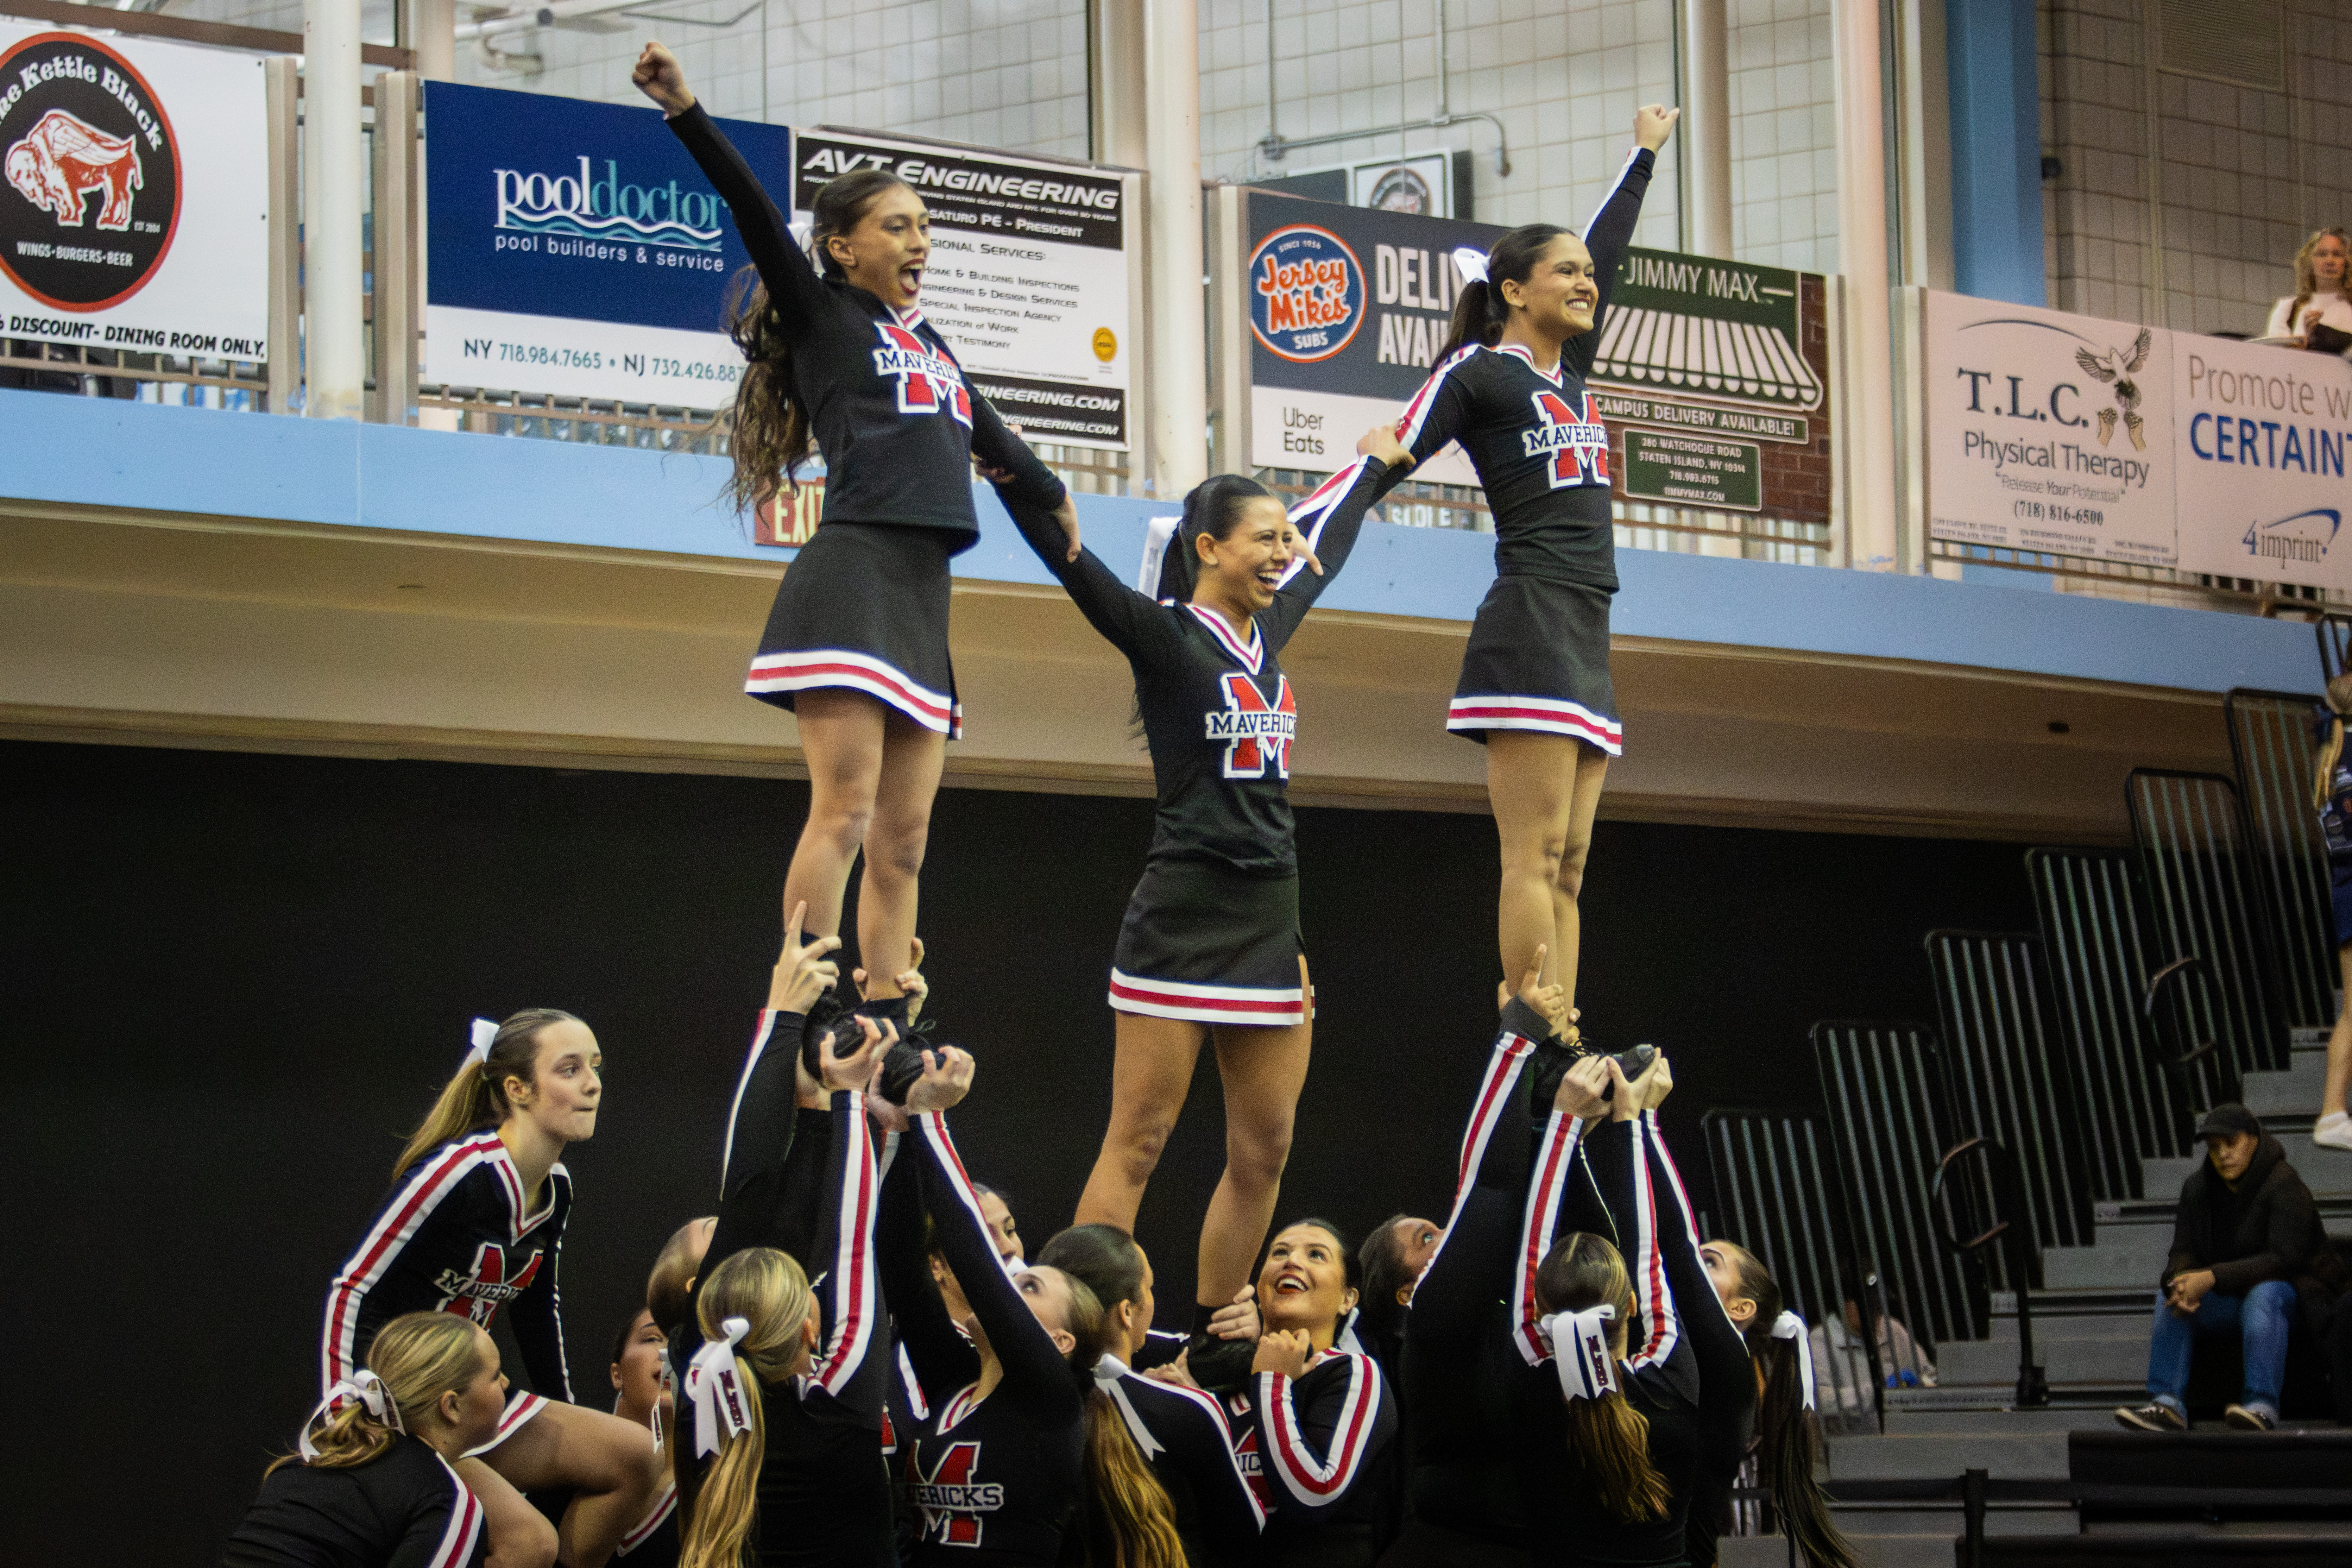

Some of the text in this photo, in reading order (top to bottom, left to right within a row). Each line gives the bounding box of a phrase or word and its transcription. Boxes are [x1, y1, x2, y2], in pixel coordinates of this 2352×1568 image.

[19, 56, 97, 93] Kettle
[101, 66, 163, 151] Black
[802, 148, 1120, 210] AVT ENGINEERING
[982, 213, 1002, 228] PE
[1016, 218, 1084, 238] PRESIDENT
[495, 234, 725, 272] pool builders & service
[1278, 240, 1300, 253] SINCE
[956, 269, 964, 278] &
[1259, 255, 1348, 296] Jersey
[1625, 256, 1759, 303] JIMMY MAX
[978, 288, 986, 297] &
[1269, 287, 1351, 334] Mike's
[10, 316, 99, 339] DISCOUNT-
[105, 325, 165, 346] DINING
[170, 334, 216, 352] ROOM
[1293, 332, 1329, 350] SUBS
[464, 339, 745, 382] NY 718.984.7665 NJ 732.426.887
[1956, 366, 2090, 428] T.L.C.
[2189, 354, 2315, 416] Promote
[1283, 407, 1324, 430] Uber
[1595, 397, 1795, 436] CAMPUS DELIVERY AVAILABLE!
[1284, 432, 1325, 455] Eats
[1525, 424, 1608, 452] MAVERIC
[1717, 445, 1742, 458] ROAD
[2190, 412, 2352, 478] CERTAIN
[1639, 451, 1672, 464] STATEN
[1709, 459, 1723, 471] NY
[1964, 429, 2150, 489] Physical Therapy
[2046, 480, 2072, 497] Your
[2014, 499, 2104, 527] (718) 816-6500
[1209, 713, 1297, 736] MAVERIC
[912, 1484, 1003, 1508] ERICKS
